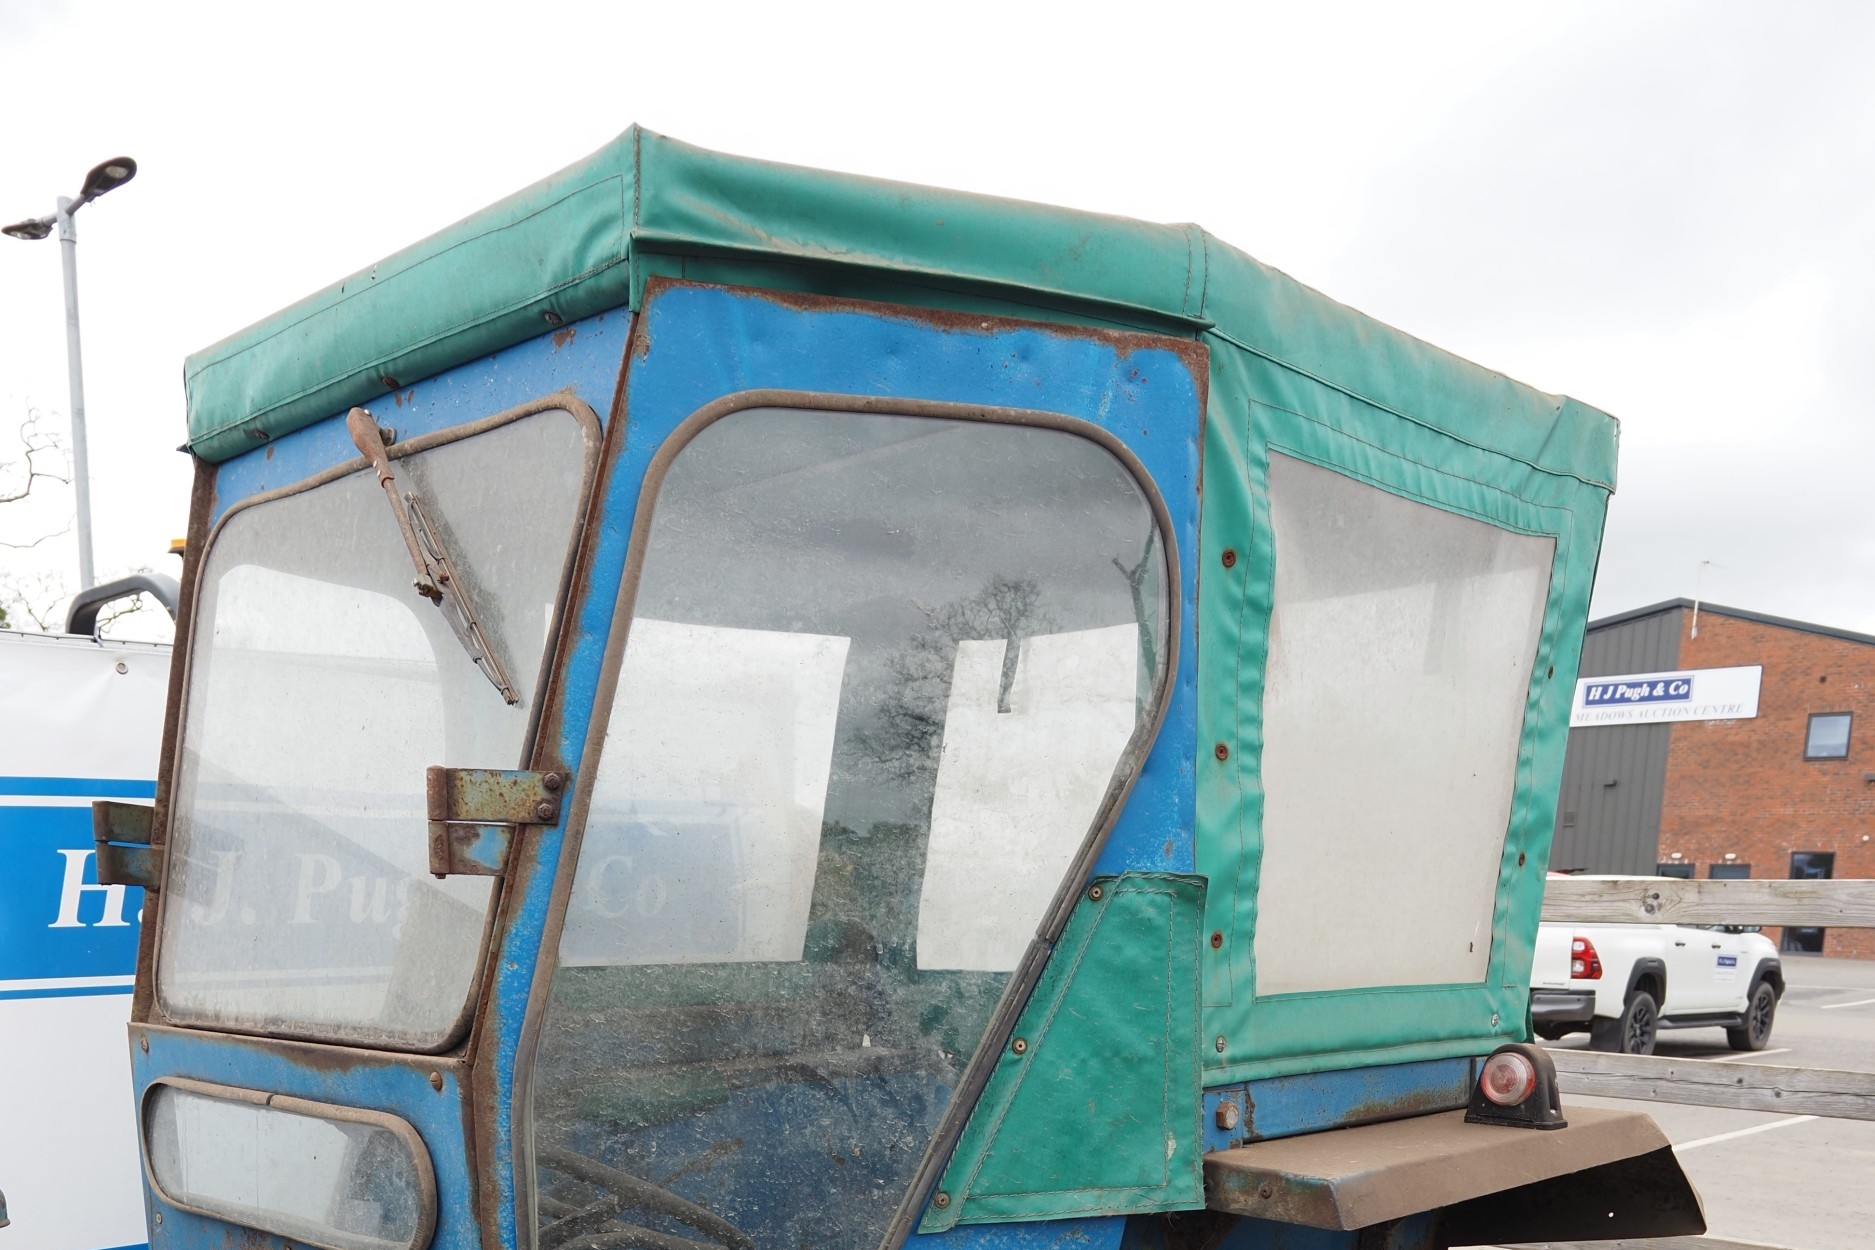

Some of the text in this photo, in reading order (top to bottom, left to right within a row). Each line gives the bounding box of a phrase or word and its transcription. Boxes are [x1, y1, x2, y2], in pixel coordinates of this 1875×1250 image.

[1588, 680, 1690, 701] H J Pugh & Co
[1576, 703, 1745, 722] MEADOWS AUCTION CENTRE
[286, 852, 412, 941] Pug
